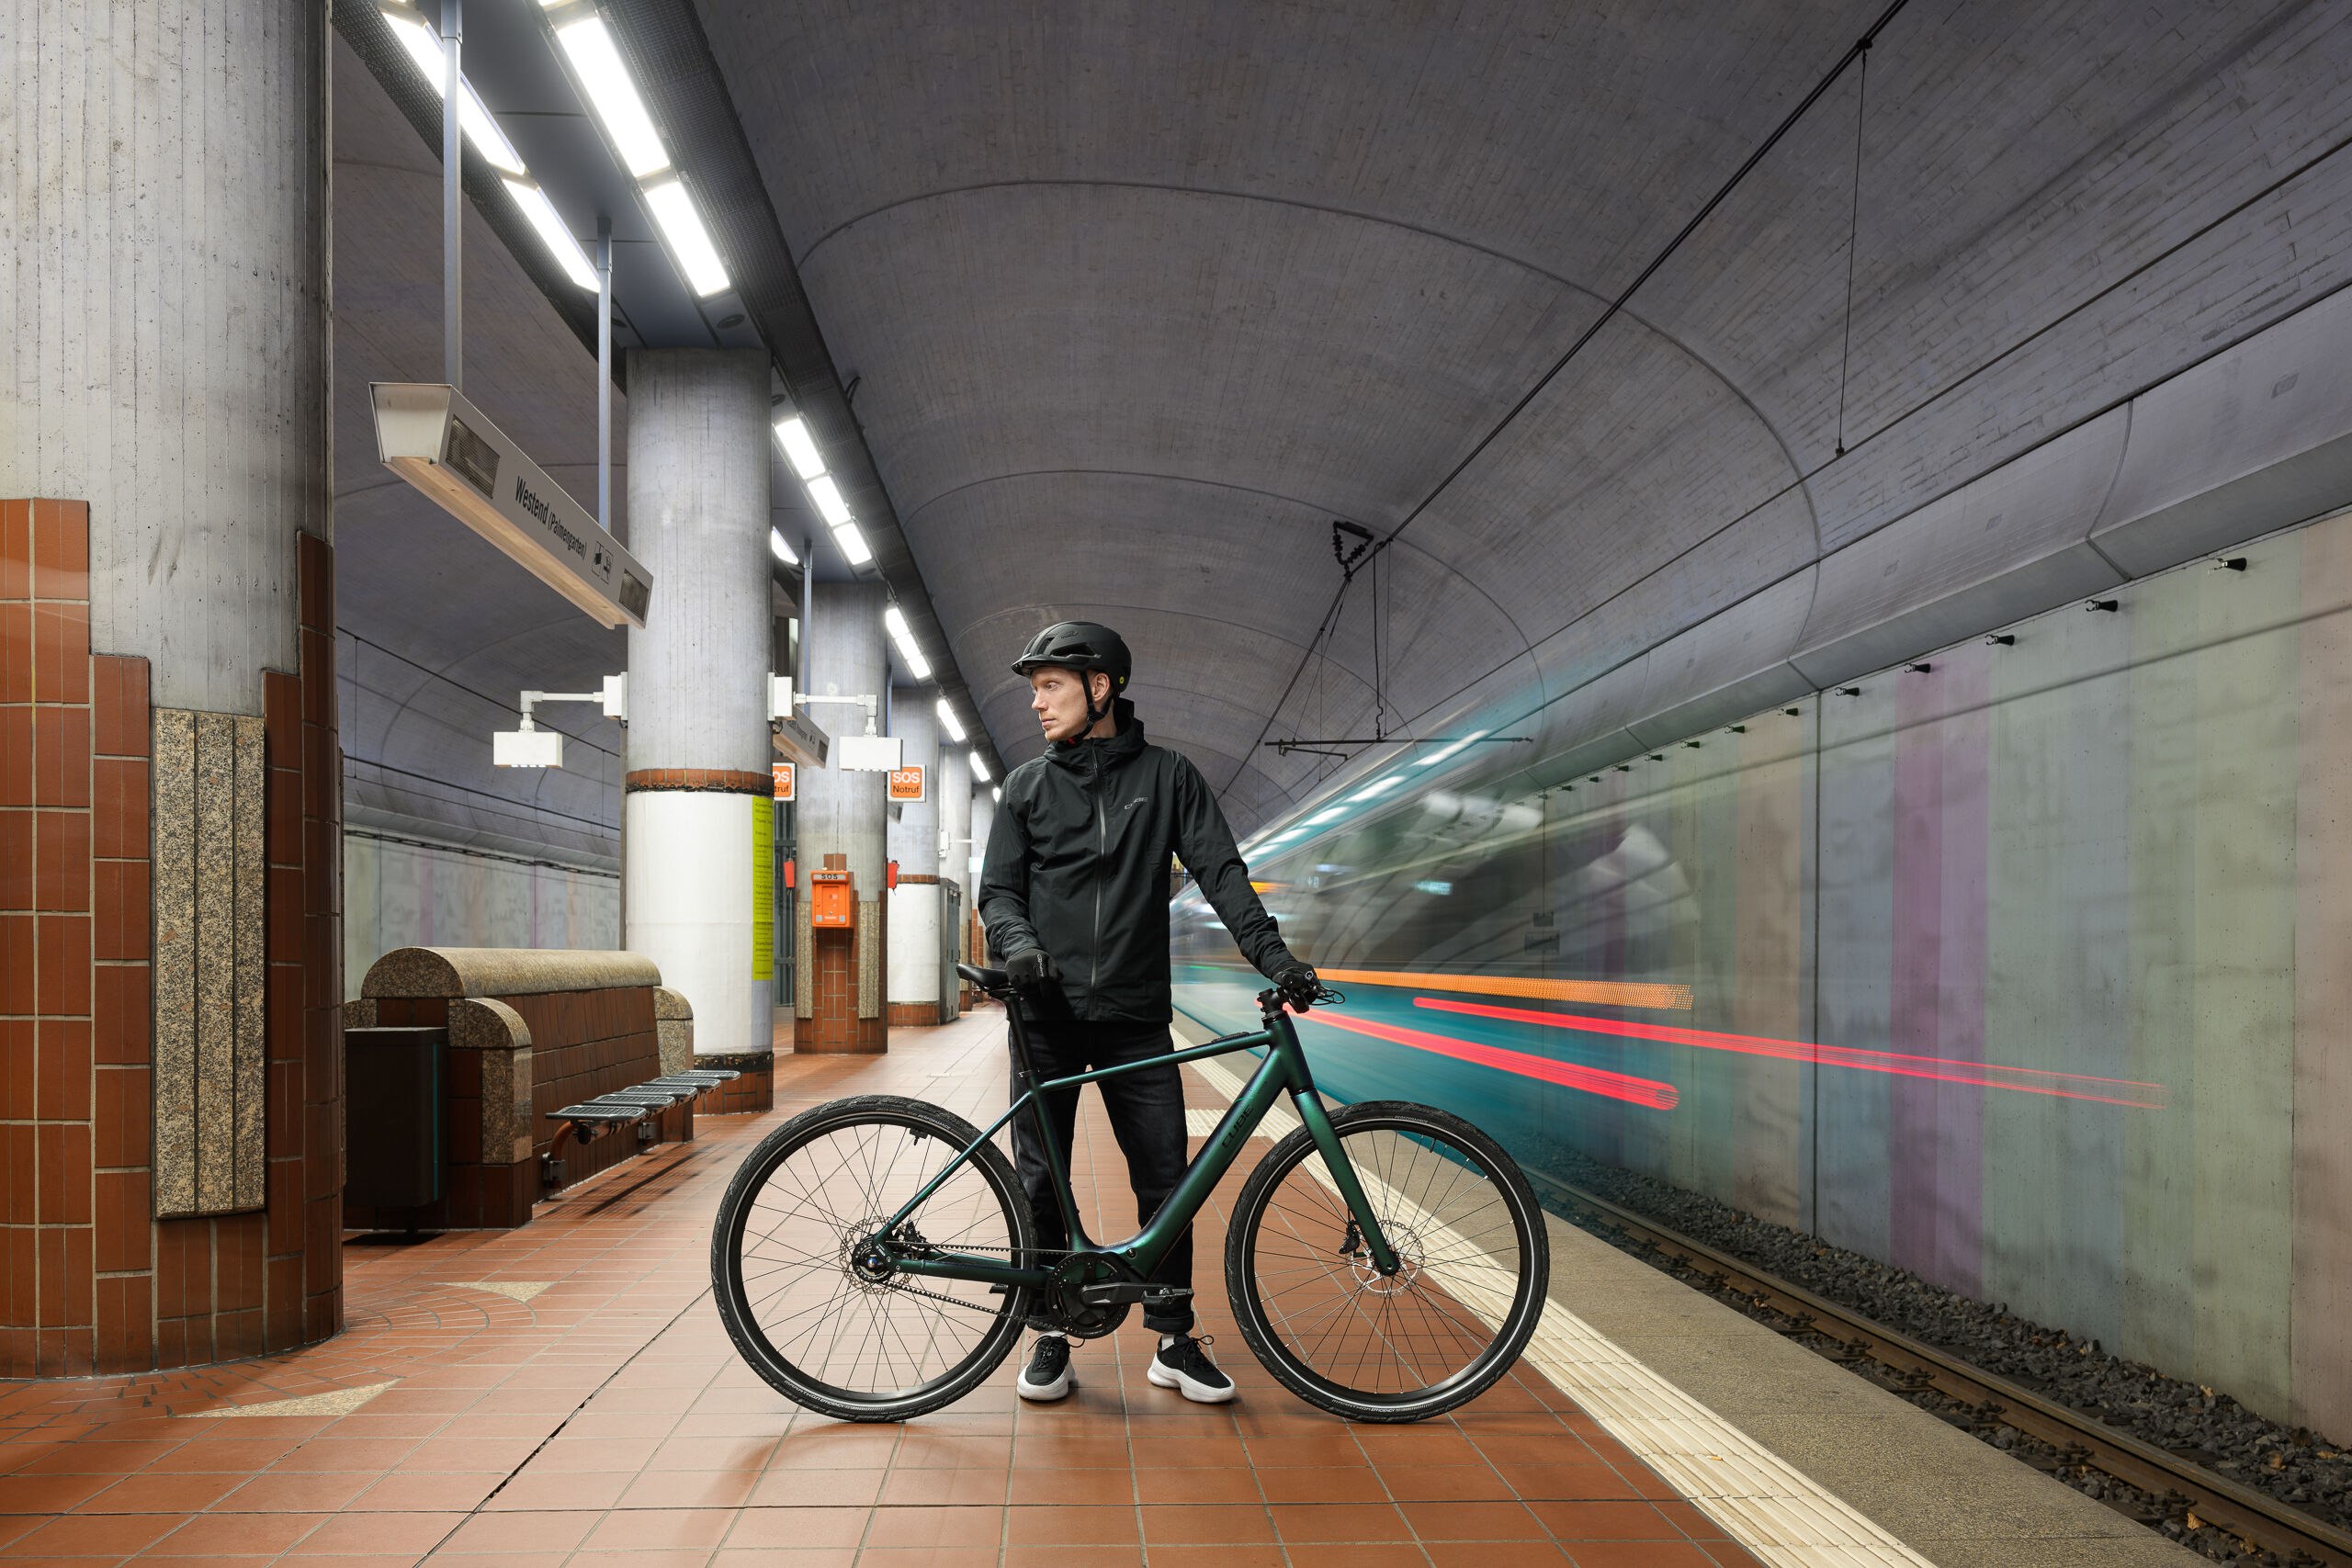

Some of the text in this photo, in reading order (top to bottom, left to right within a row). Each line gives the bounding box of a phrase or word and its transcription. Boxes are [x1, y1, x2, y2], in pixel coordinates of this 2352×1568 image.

[515, 475, 587, 560] Westend (Palmengarten)
[773, 771, 790, 783] OS
[892, 772, 921, 784] SOS
[774, 784, 789, 793] truf
[892, 784, 920, 794] Notruf
[1222, 1104, 1254, 1148] CUBE
